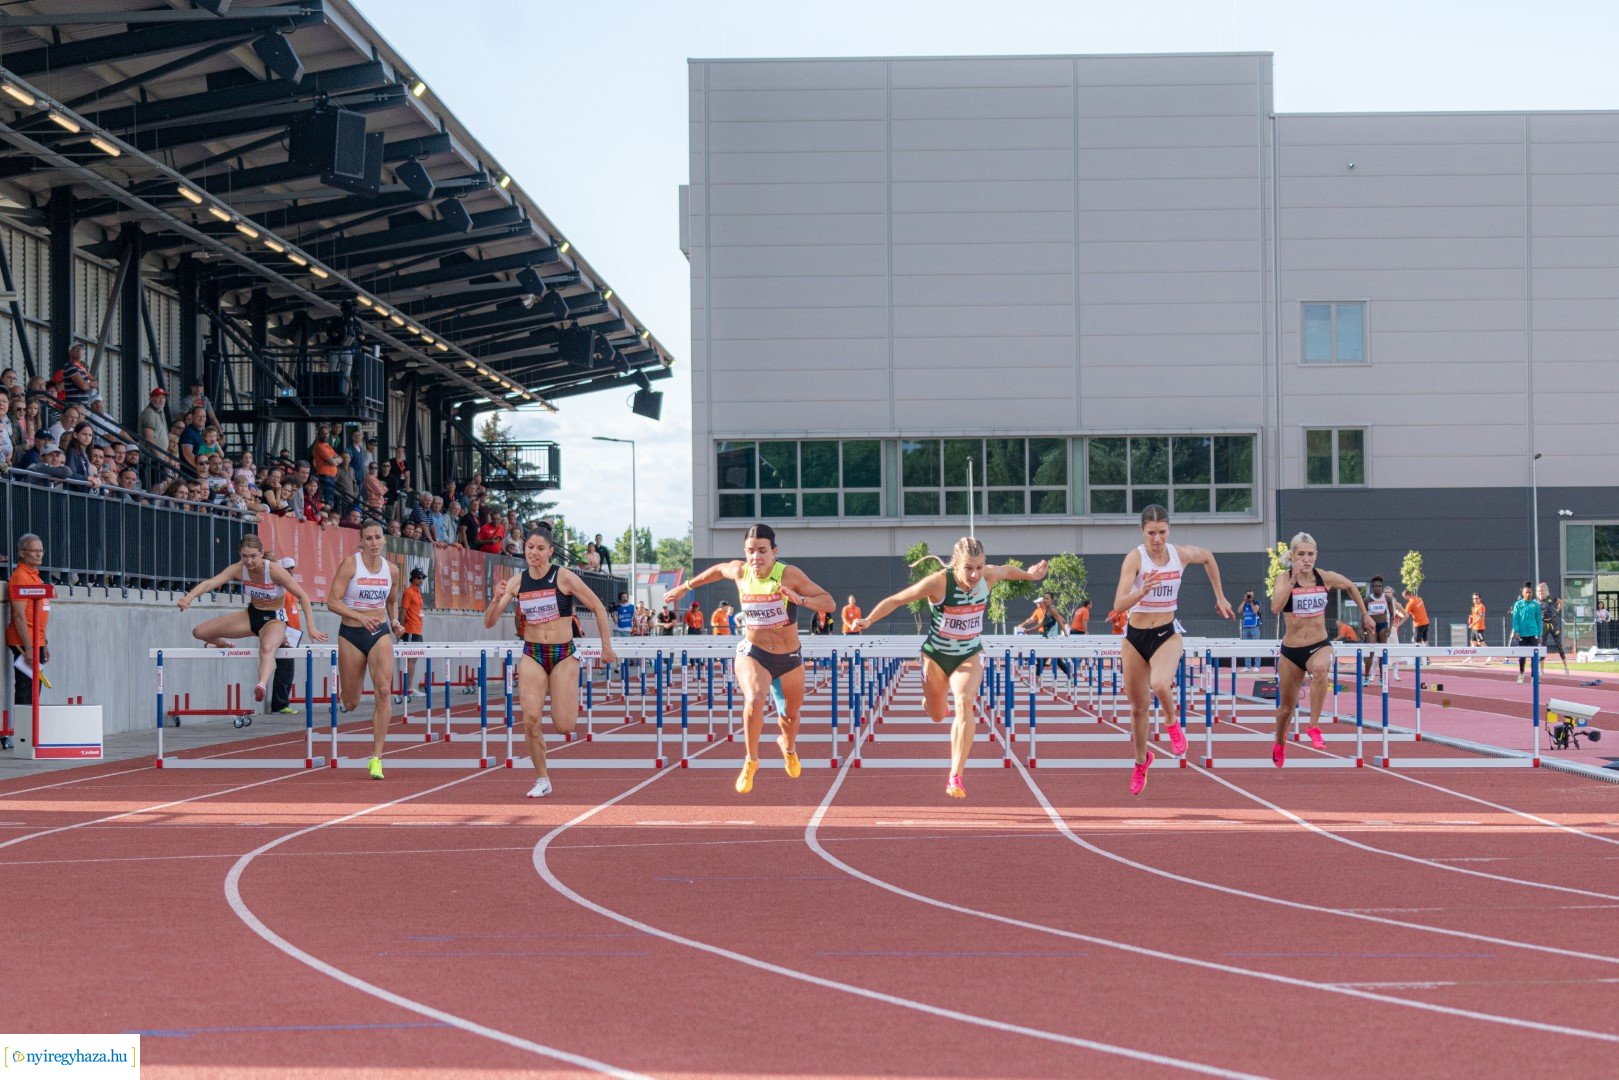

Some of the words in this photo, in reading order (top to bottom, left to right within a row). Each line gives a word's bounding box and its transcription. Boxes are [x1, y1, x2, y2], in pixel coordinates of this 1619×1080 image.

[359, 588, 386, 600] KRIZSÁN
[279, 609, 285, 621] 8
[744, 608, 776, 619] KEREKES
[776, 607, 785, 616] G.
[944, 616, 980, 631] FORSTER
[1453, 648, 1478, 656] polanik
